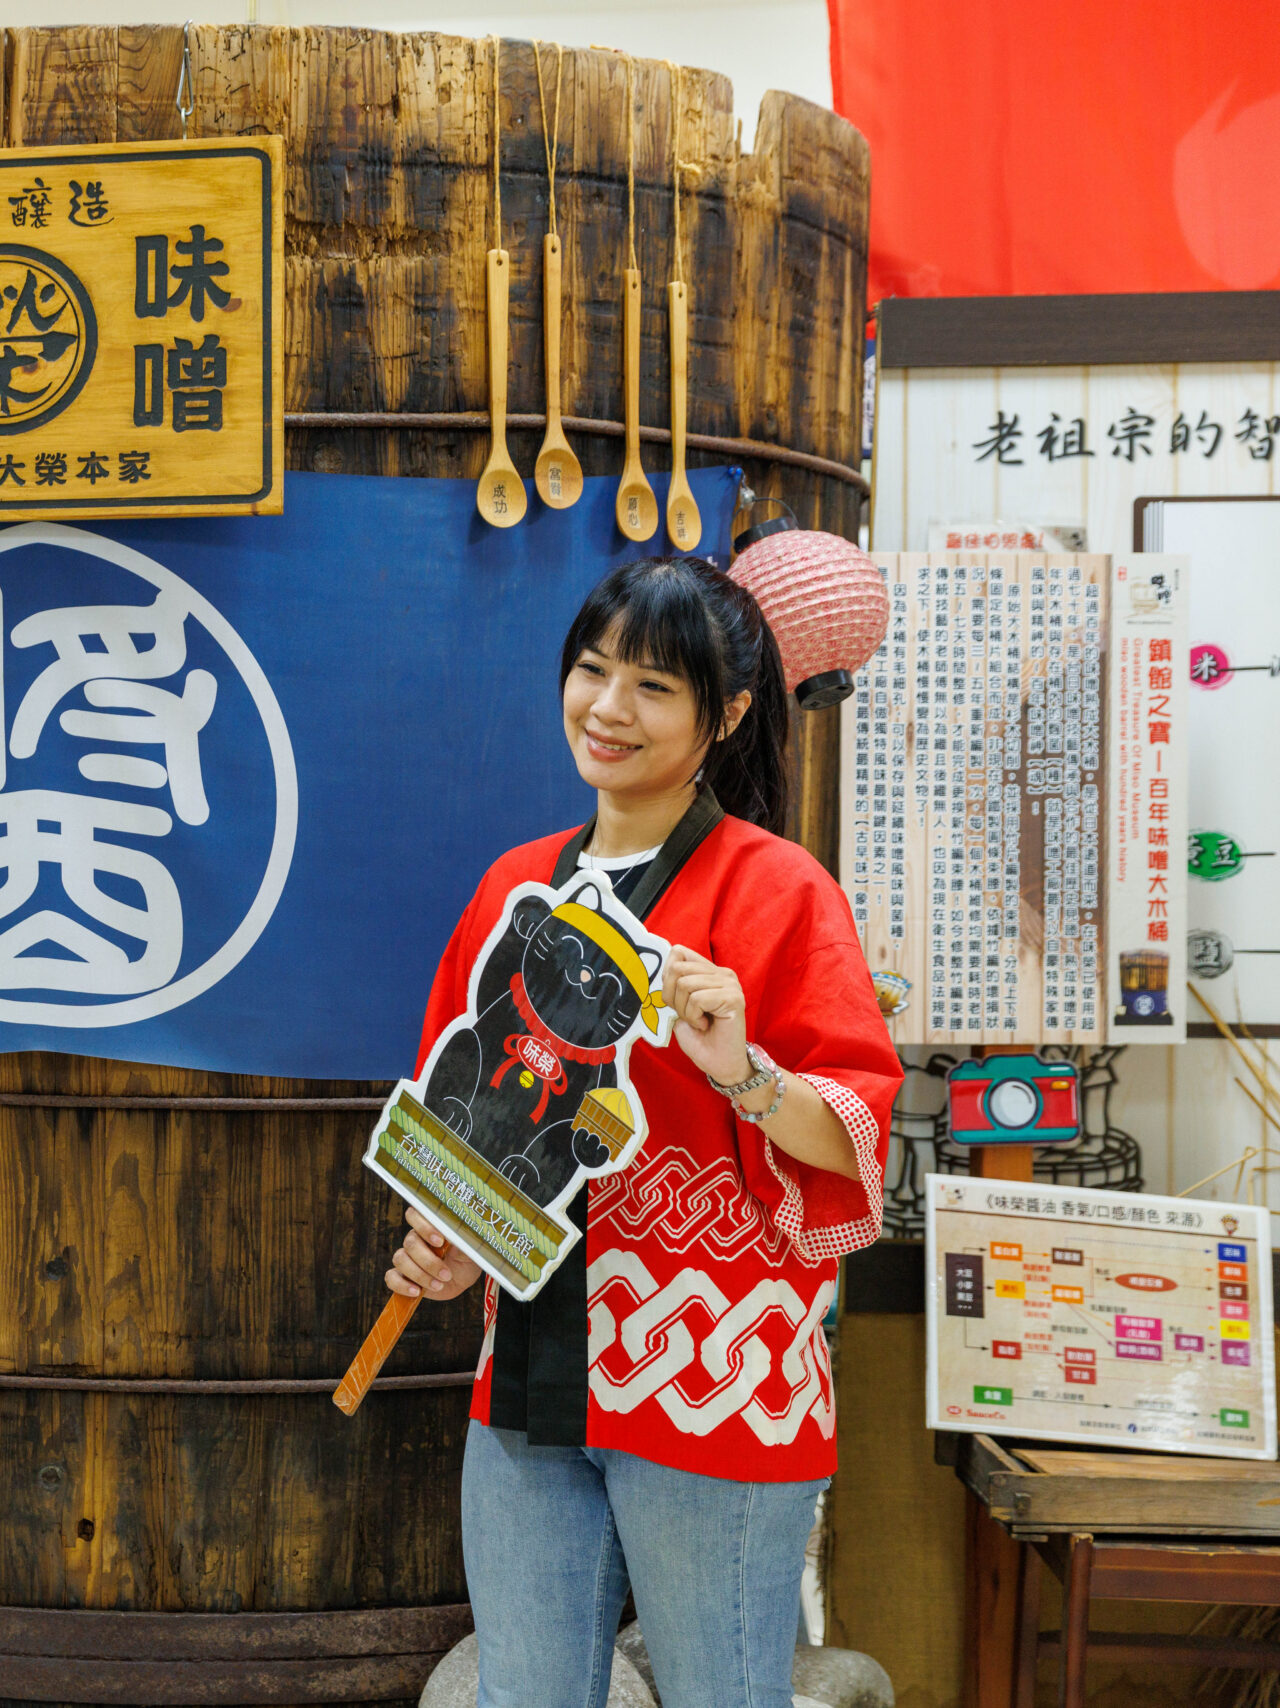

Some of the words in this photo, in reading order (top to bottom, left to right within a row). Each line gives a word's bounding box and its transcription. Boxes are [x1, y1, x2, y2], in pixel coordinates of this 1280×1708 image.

[132, 225, 232, 433] 味噌
[973, 406, 1280, 467] 老祖宗的智
[492, 483, 508, 515] 成功
[1120, 638, 1128, 662] miso
[1132, 637, 1143, 687] Greatest
[1191, 651, 1218, 682] 米
[1120, 665, 1128, 706] wooden
[1132, 691, 1143, 740] Treasure
[1119, 744, 1128, 765] with
[1132, 762, 1142, 789] Miso
[1118, 768, 1128, 811] hundred
[1131, 792, 1142, 840] Museum
[522, 1039, 557, 1077] 味榮
[393, 1148, 423, 1182] Taiwan
[423, 1176, 446, 1202] Miso
[445, 1196, 485, 1236] Cultural
[483, 1230, 524, 1272] Museum
[399, 1132, 535, 1260] 台灣味噌釀造文化館
